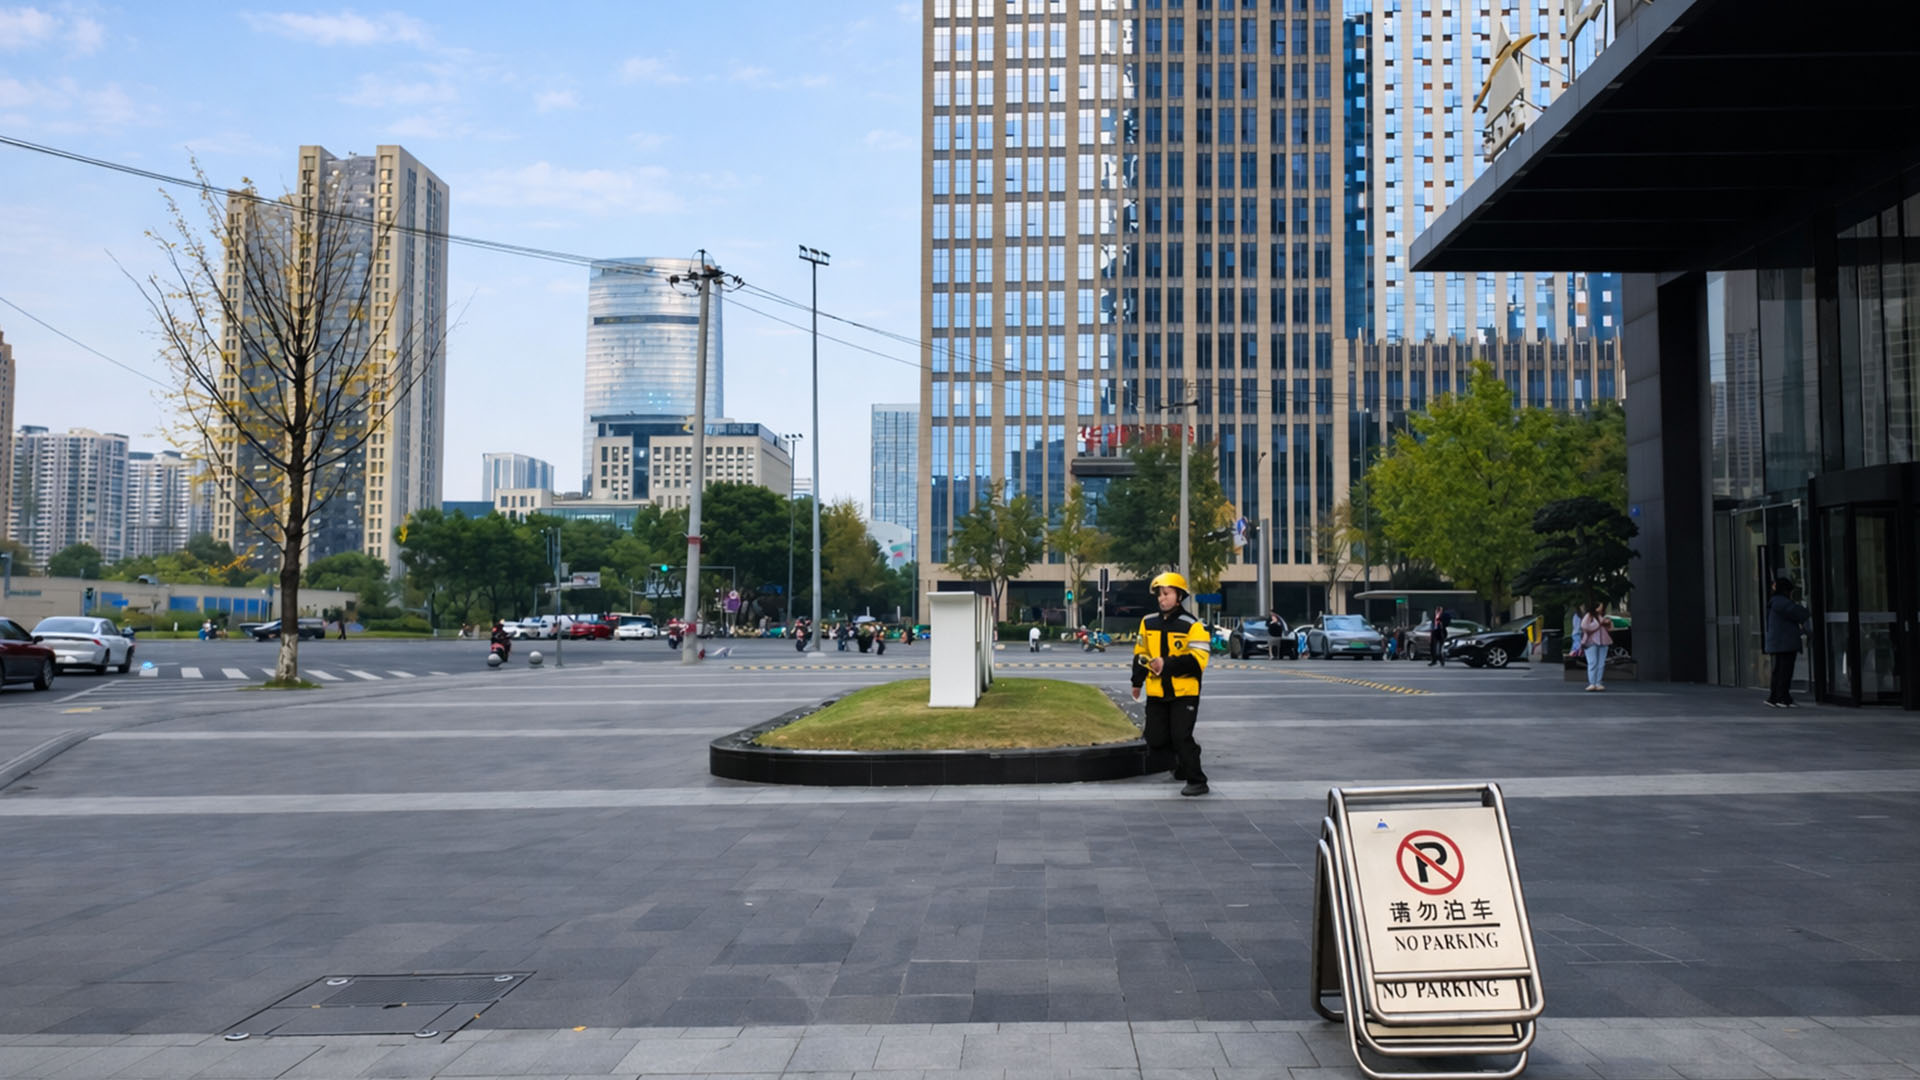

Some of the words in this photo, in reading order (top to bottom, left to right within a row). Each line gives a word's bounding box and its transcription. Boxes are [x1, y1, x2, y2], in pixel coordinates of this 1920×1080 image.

[1389, 898, 1493, 923] 请勿泊车
[1394, 935, 1419, 951] NO
[1422, 932, 1499, 950] PARKING
[1383, 982, 1407, 999] NO
[1416, 980, 1499, 998] PARKING
